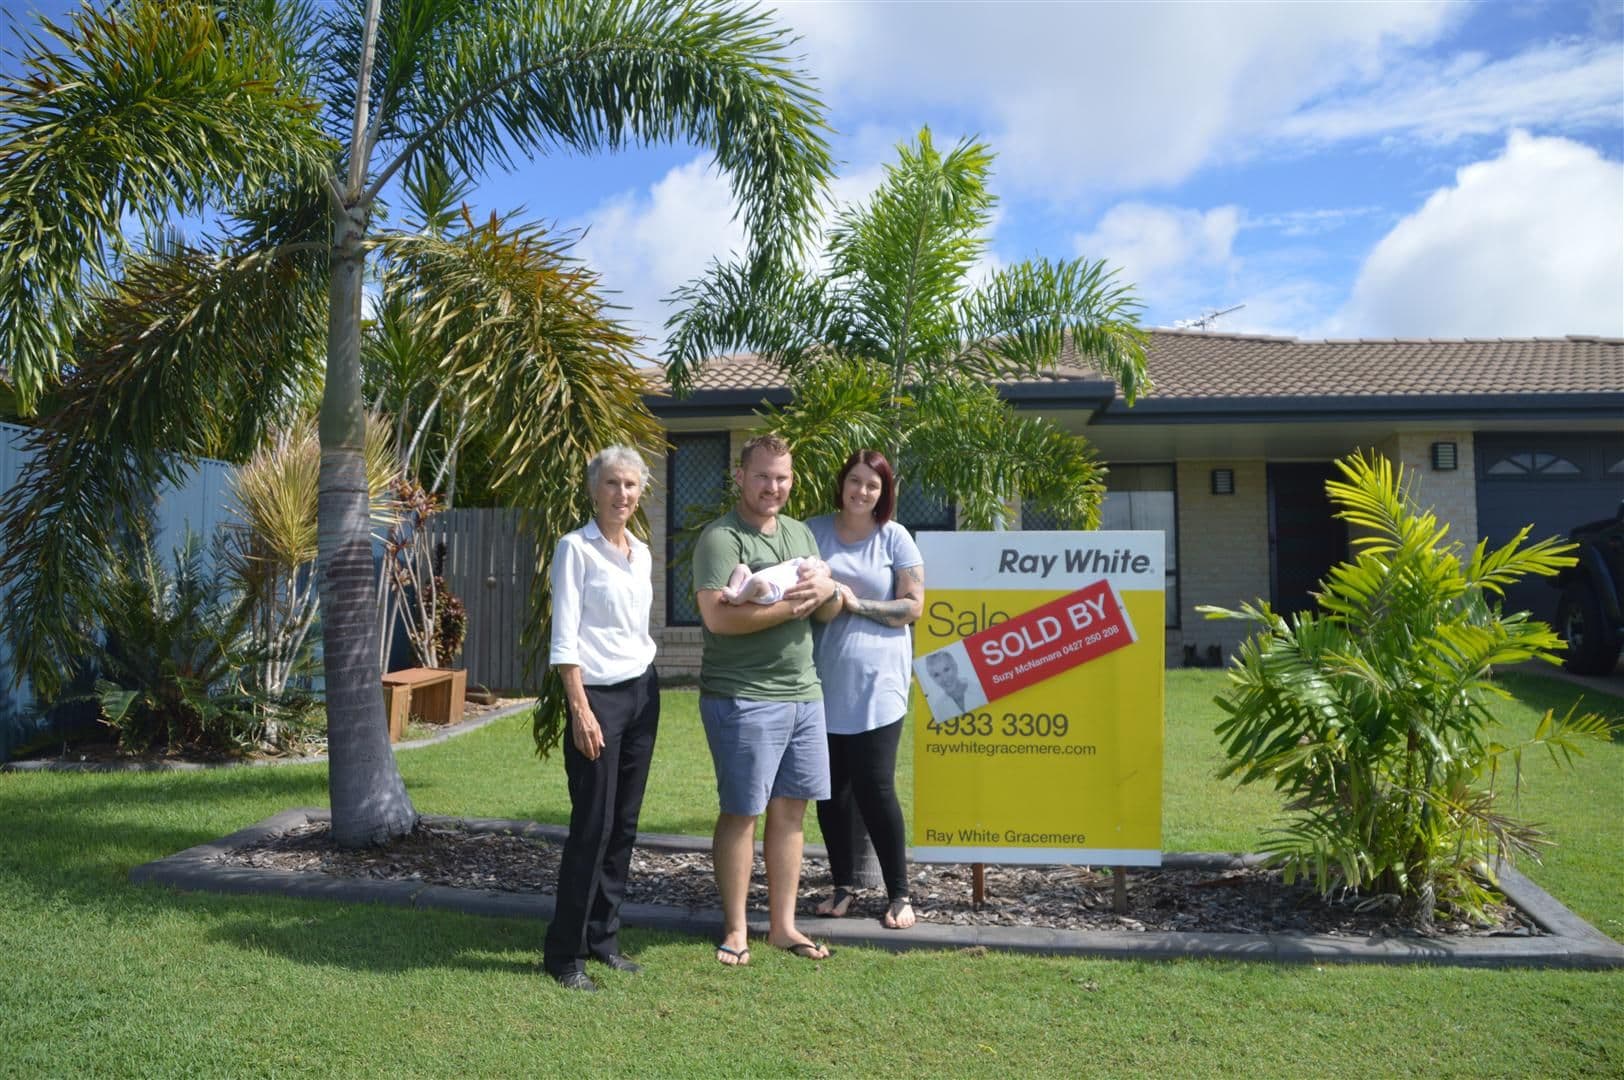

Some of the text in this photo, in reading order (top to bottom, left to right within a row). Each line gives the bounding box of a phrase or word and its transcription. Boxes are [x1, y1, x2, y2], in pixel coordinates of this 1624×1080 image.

[999, 548, 1058, 578] Ray
[928, 601, 1010, 637] Sale
[981, 593, 1106, 665] SOLD BY
[992, 670, 1015, 685] Suzy
[1014, 649, 1062, 674] McNamara
[1062, 640, 1084, 655] 0427
[1002, 712, 1069, 737] 3309
[926, 741, 1096, 757] raywhitegracemere.com
[926, 829, 1086, 845] Ray White Gracemere
